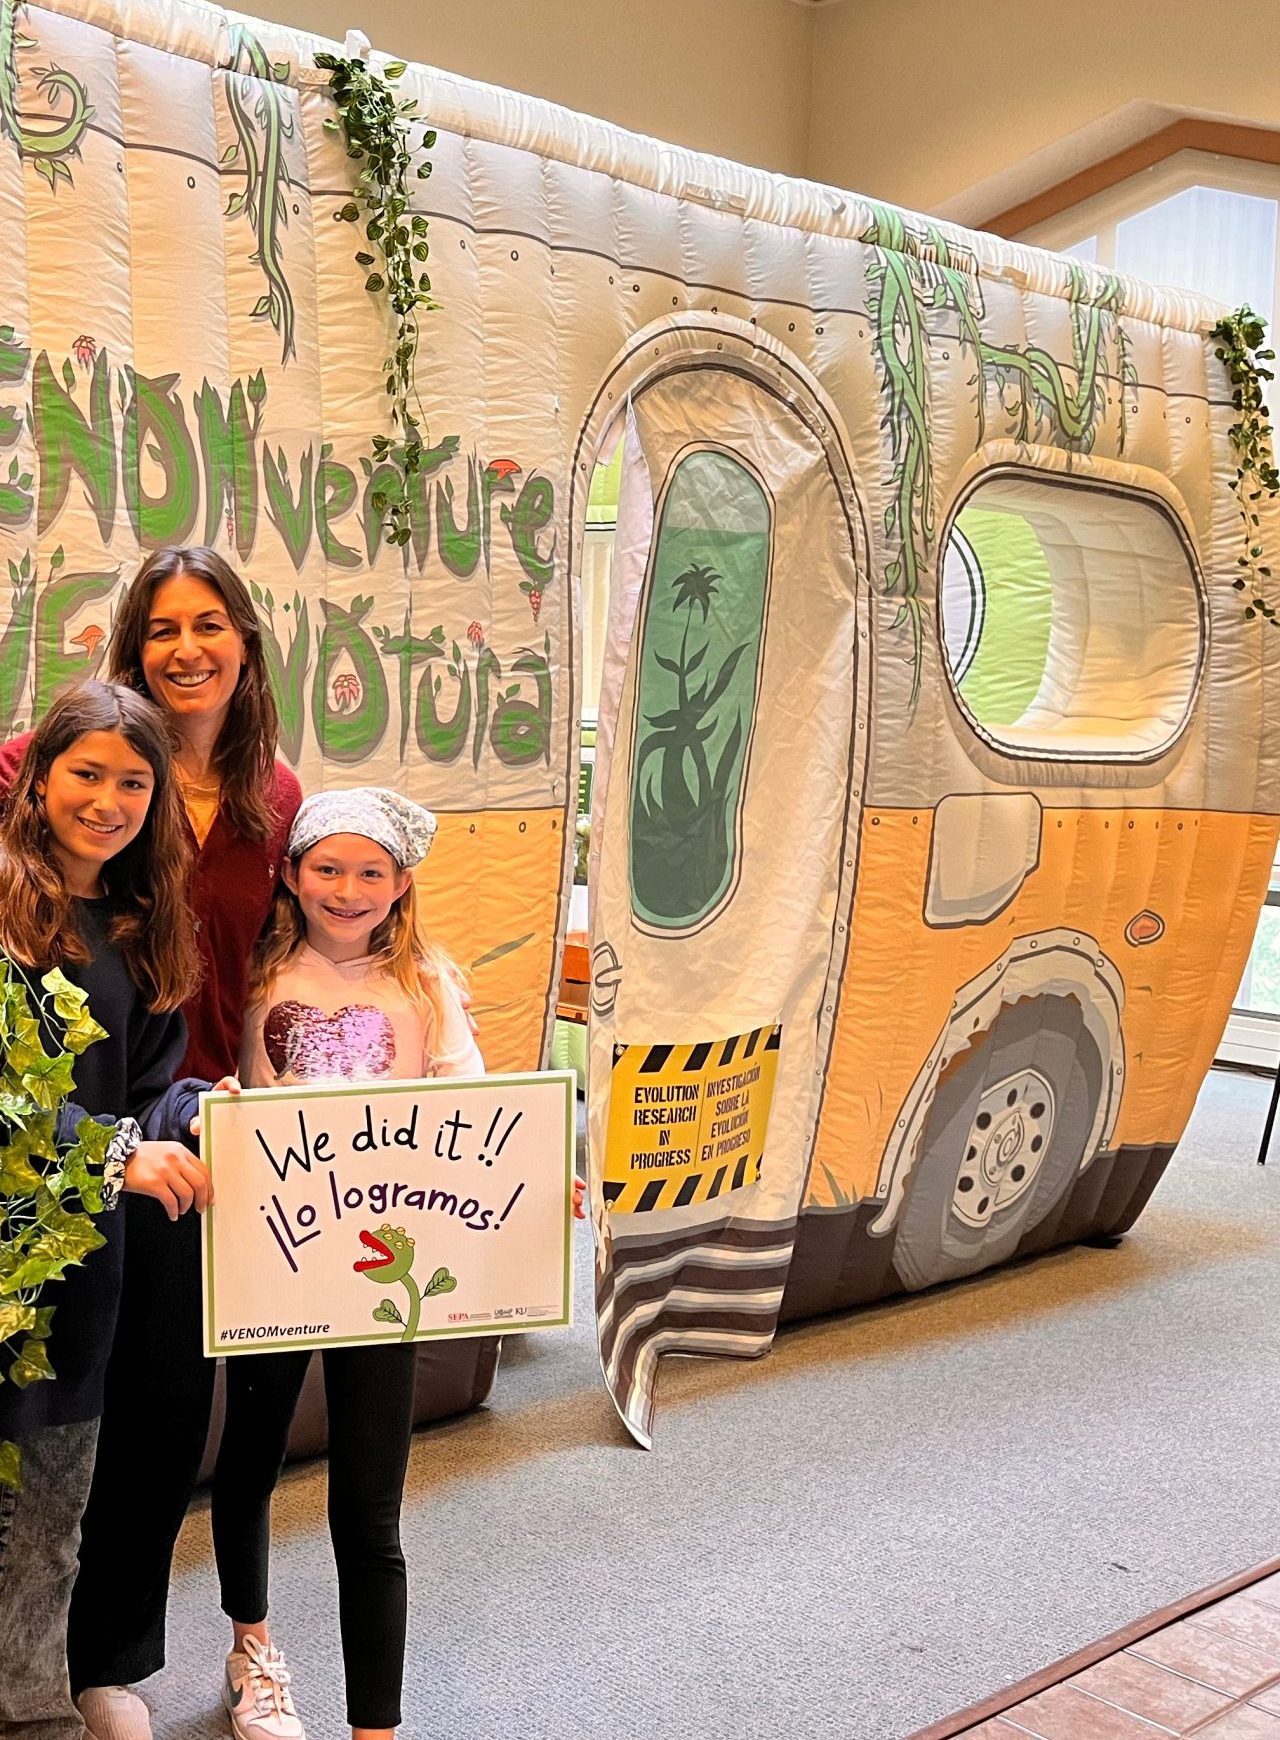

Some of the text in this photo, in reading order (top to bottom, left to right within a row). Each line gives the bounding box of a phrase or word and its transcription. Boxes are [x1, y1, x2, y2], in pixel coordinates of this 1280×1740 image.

[706, 1062, 761, 1098] INVESTIGACIÓN
[635, 1084, 699, 1103] EVOLUTION
[715, 1090, 750, 1116] SOBRE LA
[633, 1106, 697, 1126] RESEARCH
[255, 1110, 336, 1182] We
[351, 1104, 419, 1152] did
[659, 1130, 670, 1146] IN
[701, 1129, 751, 1162] EN PROGRESO
[630, 1149, 691, 1170] PROGRESS
[329, 1170, 525, 1231] logramos!
[220, 1322, 330, 1341] #VENOMventure
